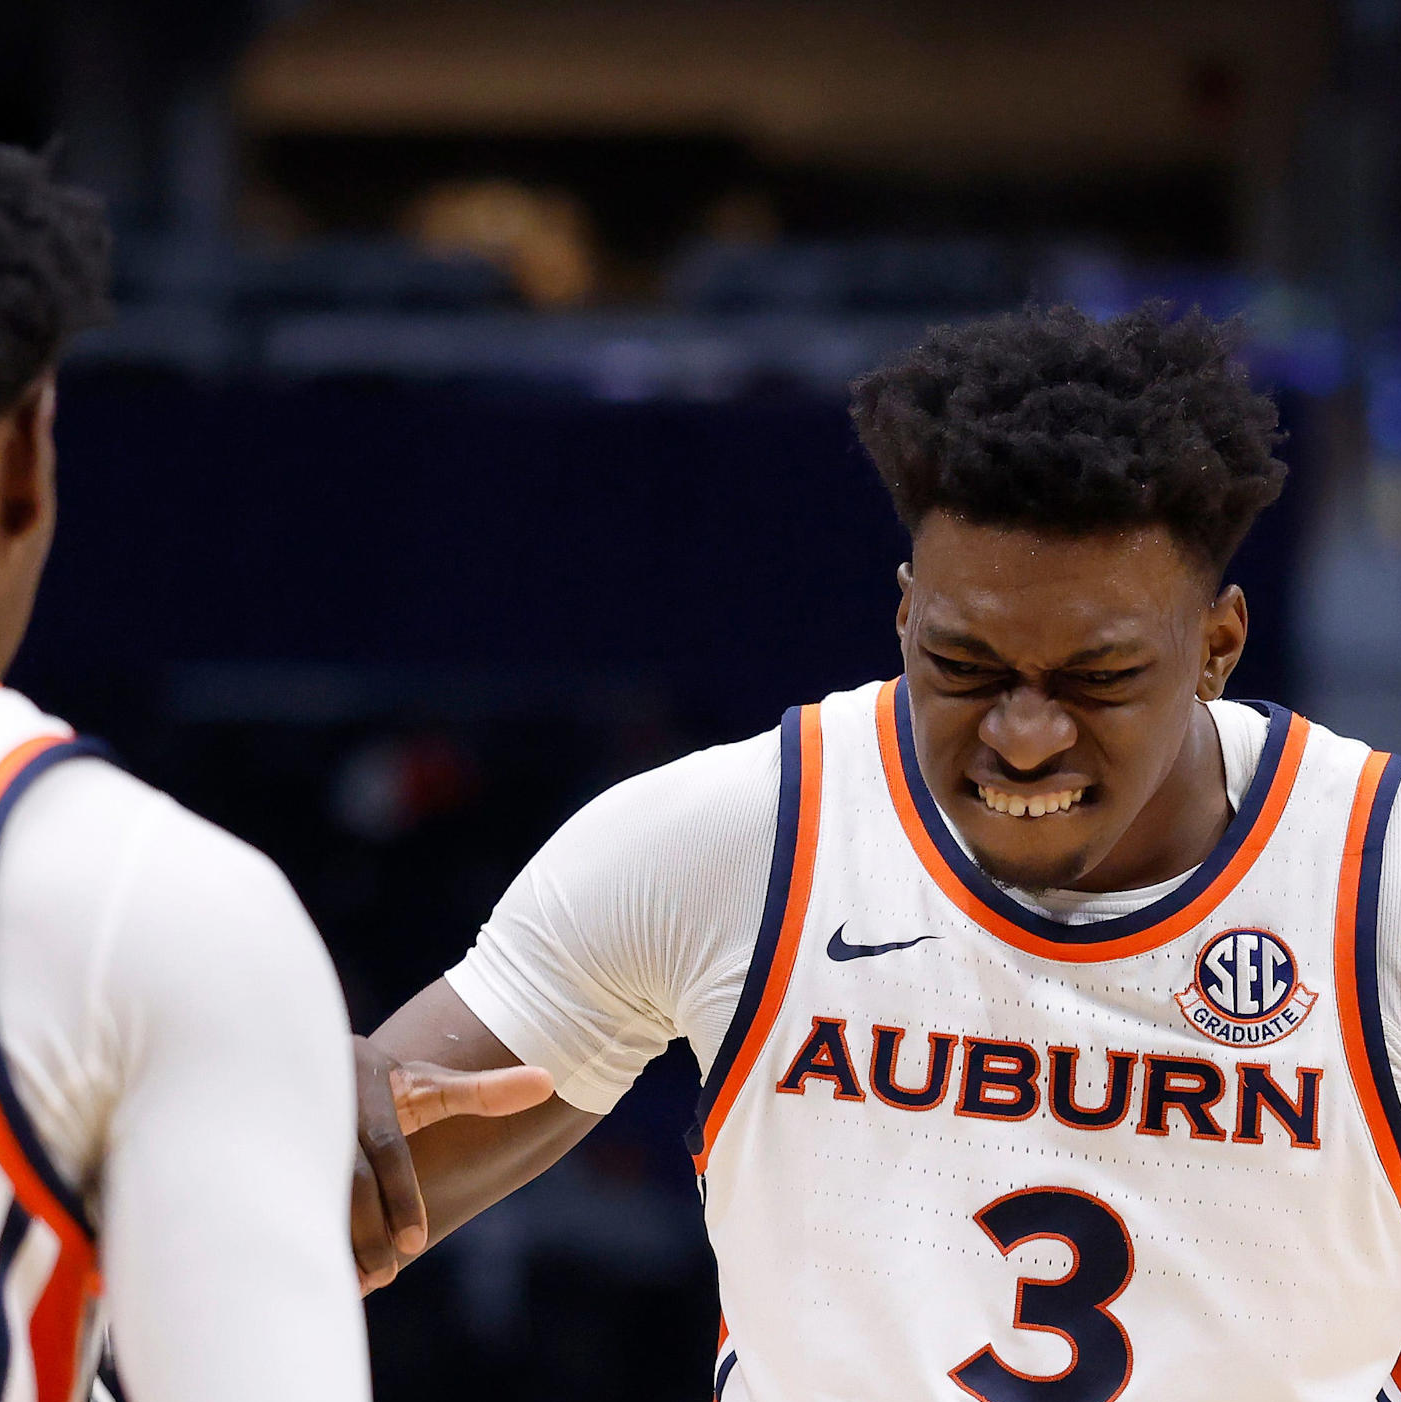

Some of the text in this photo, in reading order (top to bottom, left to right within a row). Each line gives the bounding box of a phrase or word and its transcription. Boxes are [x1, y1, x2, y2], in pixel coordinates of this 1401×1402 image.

[1204, 933, 1288, 1015] SEC
[1193, 1007, 1300, 1043] GRADUATE
[776, 1015, 1324, 1150] AUBURN
